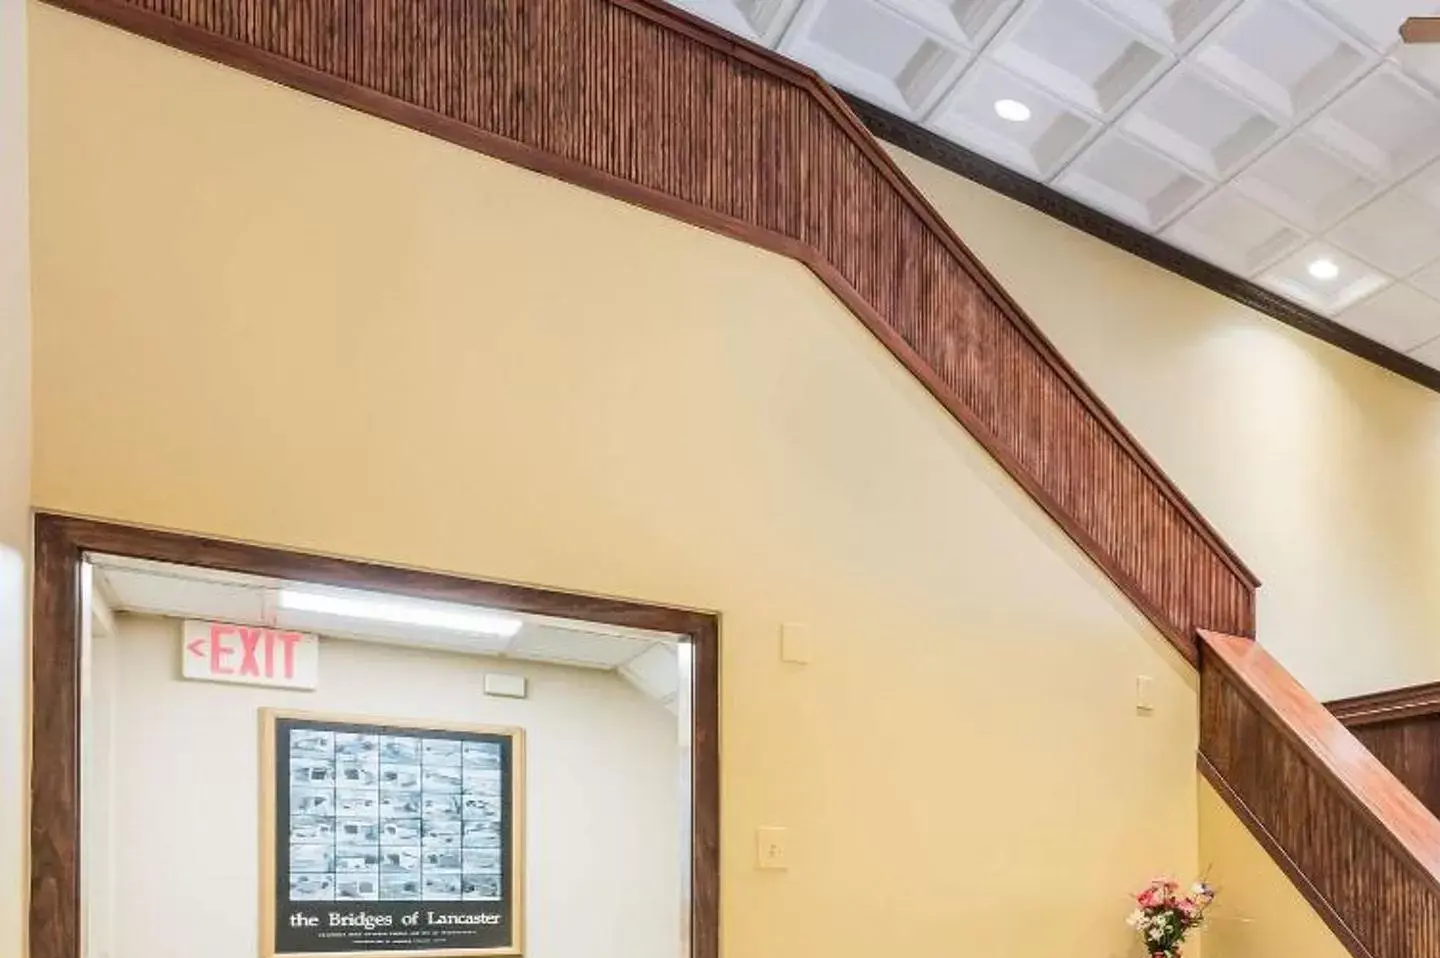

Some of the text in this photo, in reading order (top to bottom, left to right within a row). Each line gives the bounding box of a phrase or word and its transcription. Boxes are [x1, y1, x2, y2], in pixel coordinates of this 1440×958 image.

[210, 624, 303, 679] EXIT
[290, 911, 502, 930] the Bridges of Lancaster
